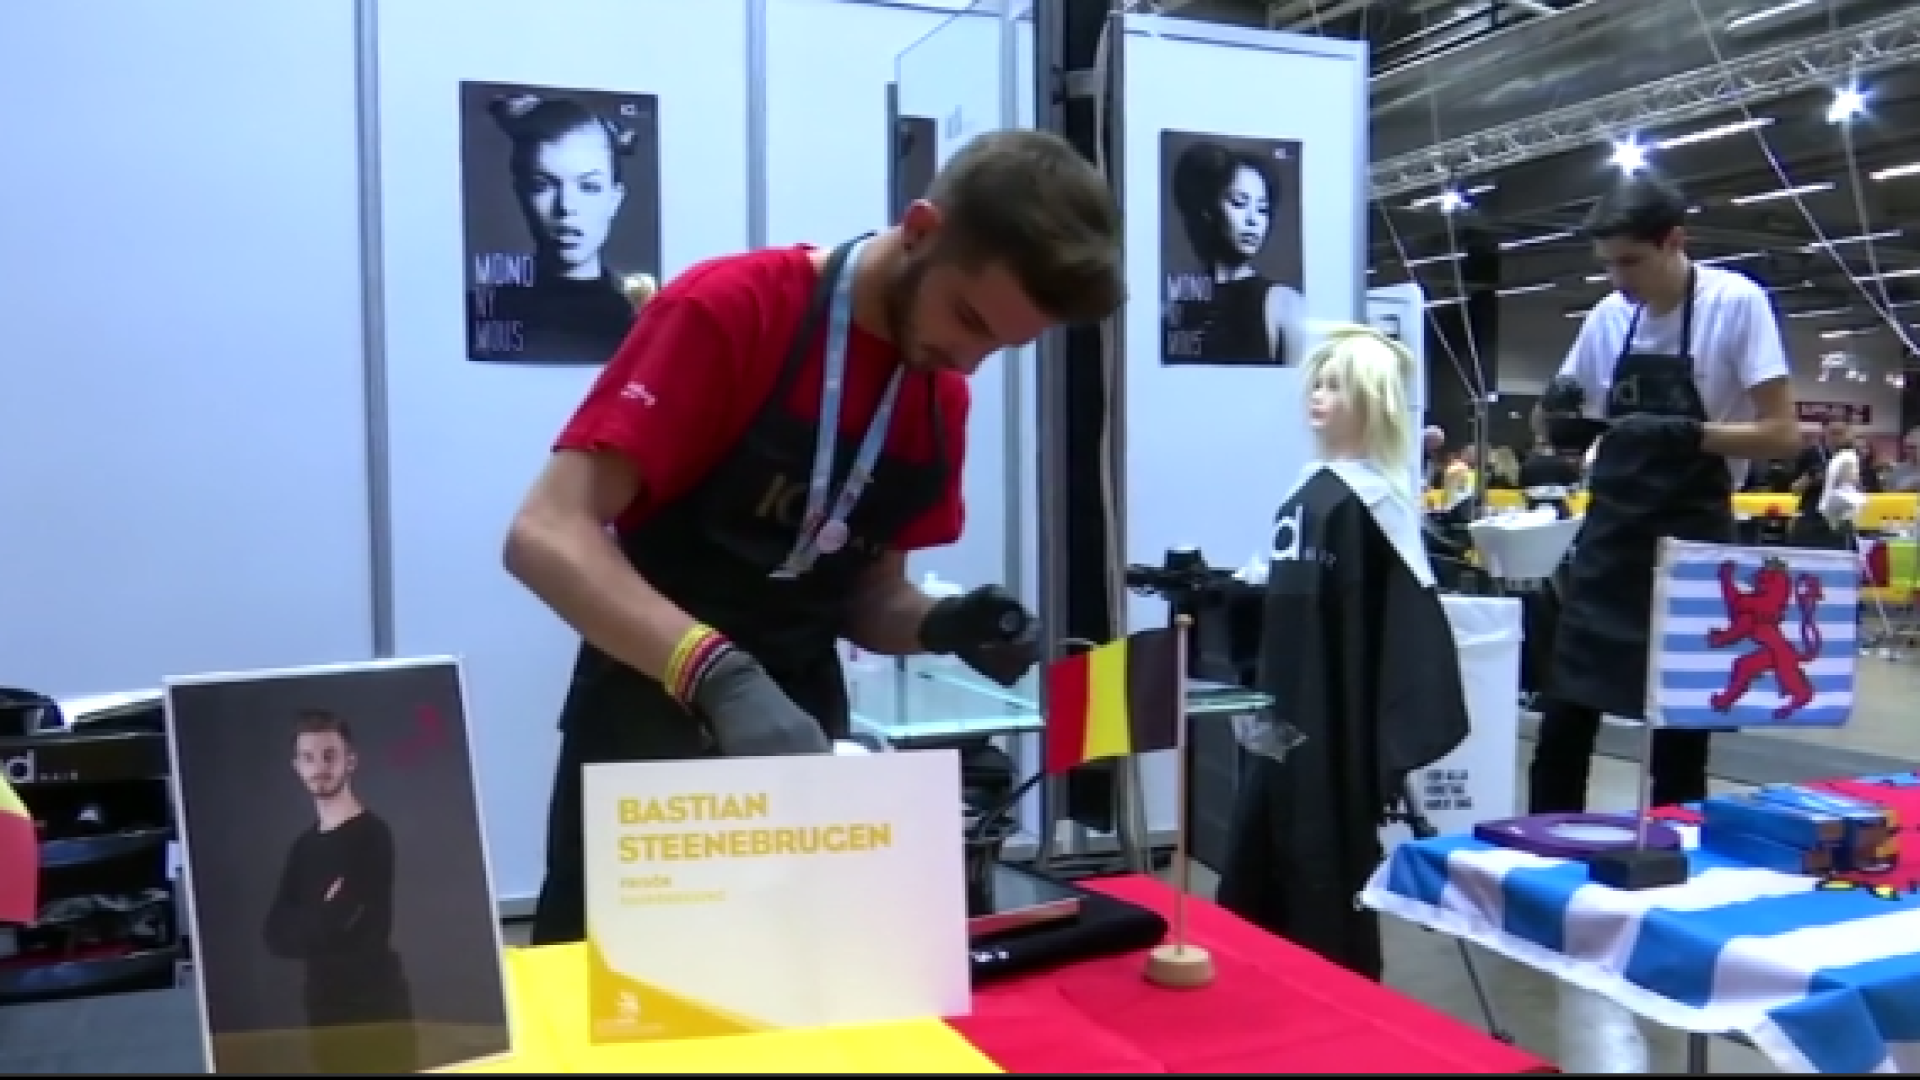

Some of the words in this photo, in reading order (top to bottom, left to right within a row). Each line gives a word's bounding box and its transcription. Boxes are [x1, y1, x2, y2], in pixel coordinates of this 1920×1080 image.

[475, 252, 534, 288] MONO
[1167, 272, 1212, 302] MONO
[617, 792, 768, 825] BASTIAN
[617, 822, 893, 864] STEENEBRUGEN
